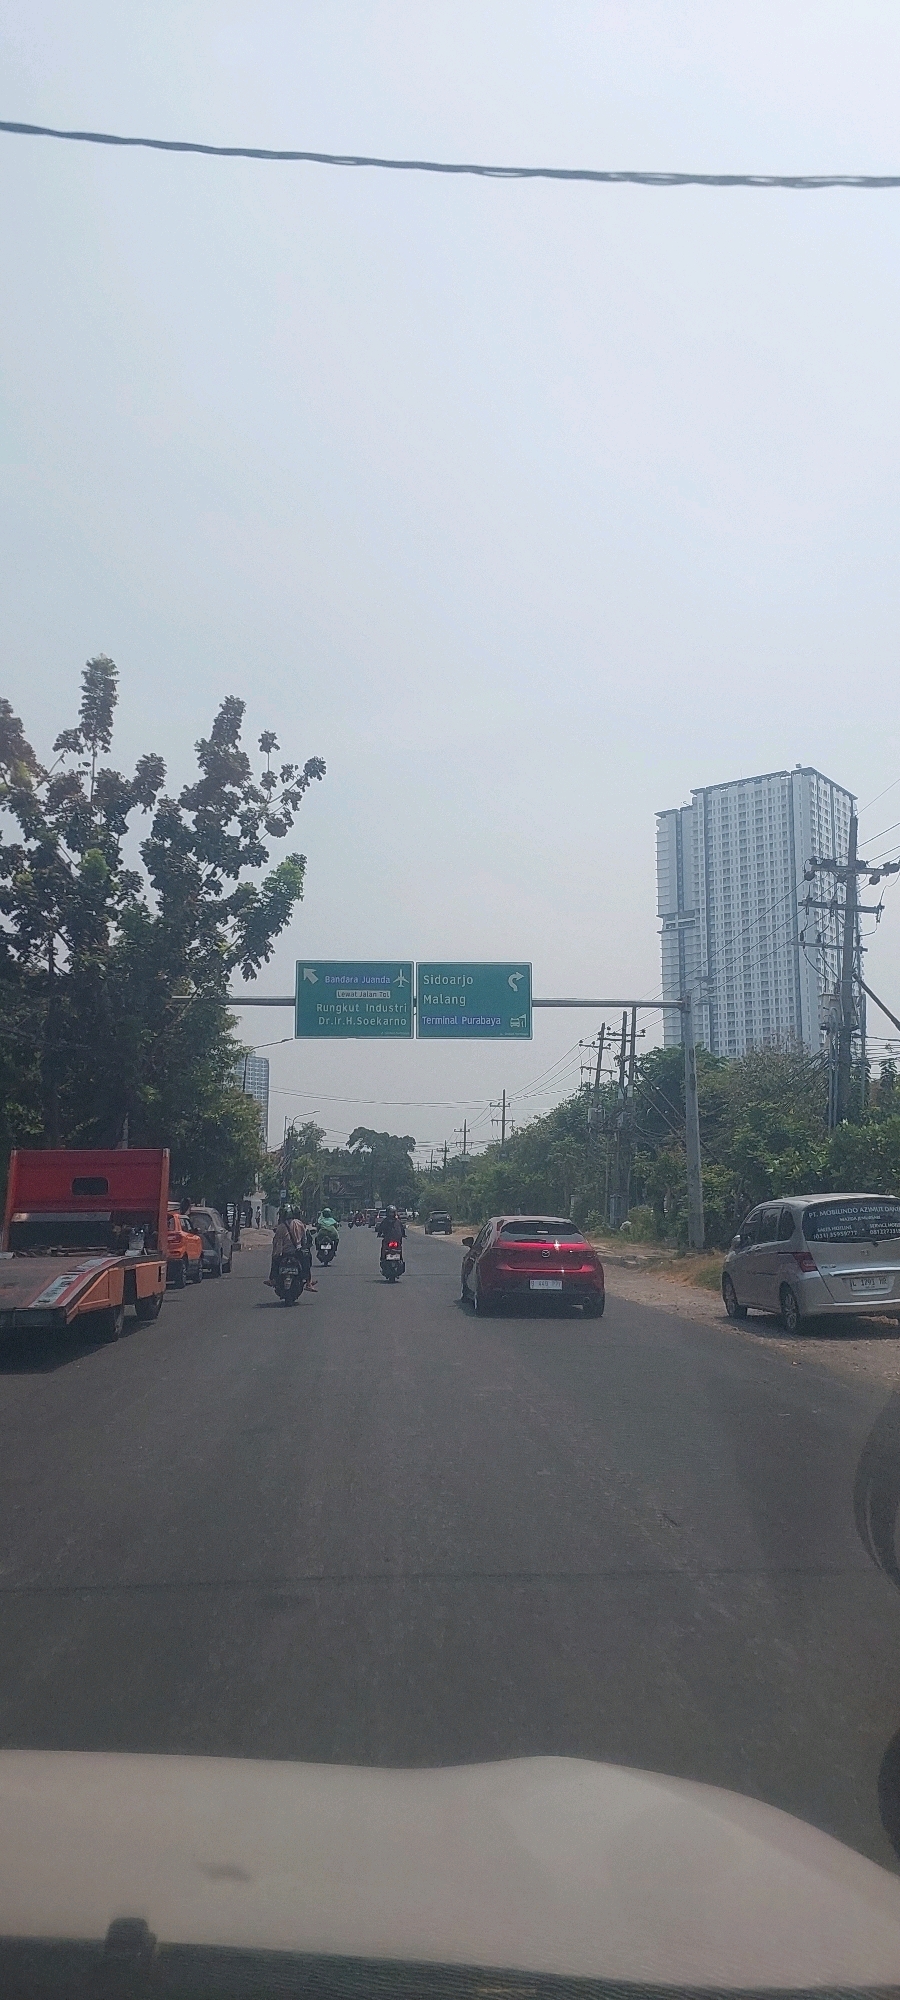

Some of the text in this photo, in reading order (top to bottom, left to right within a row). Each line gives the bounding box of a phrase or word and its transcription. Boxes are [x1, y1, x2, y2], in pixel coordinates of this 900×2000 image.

[325, 975, 391, 984] Bandara Juanda
[423, 974, 473, 987] Sidoarjo
[423, 993, 466, 1007] Malang
[316, 1003, 408, 1014] Rungkut Industri
[318, 1016, 407, 1026] Dr.Ir.H.Soekarno
[422, 1016, 501, 1027] Terminal Purabaya
